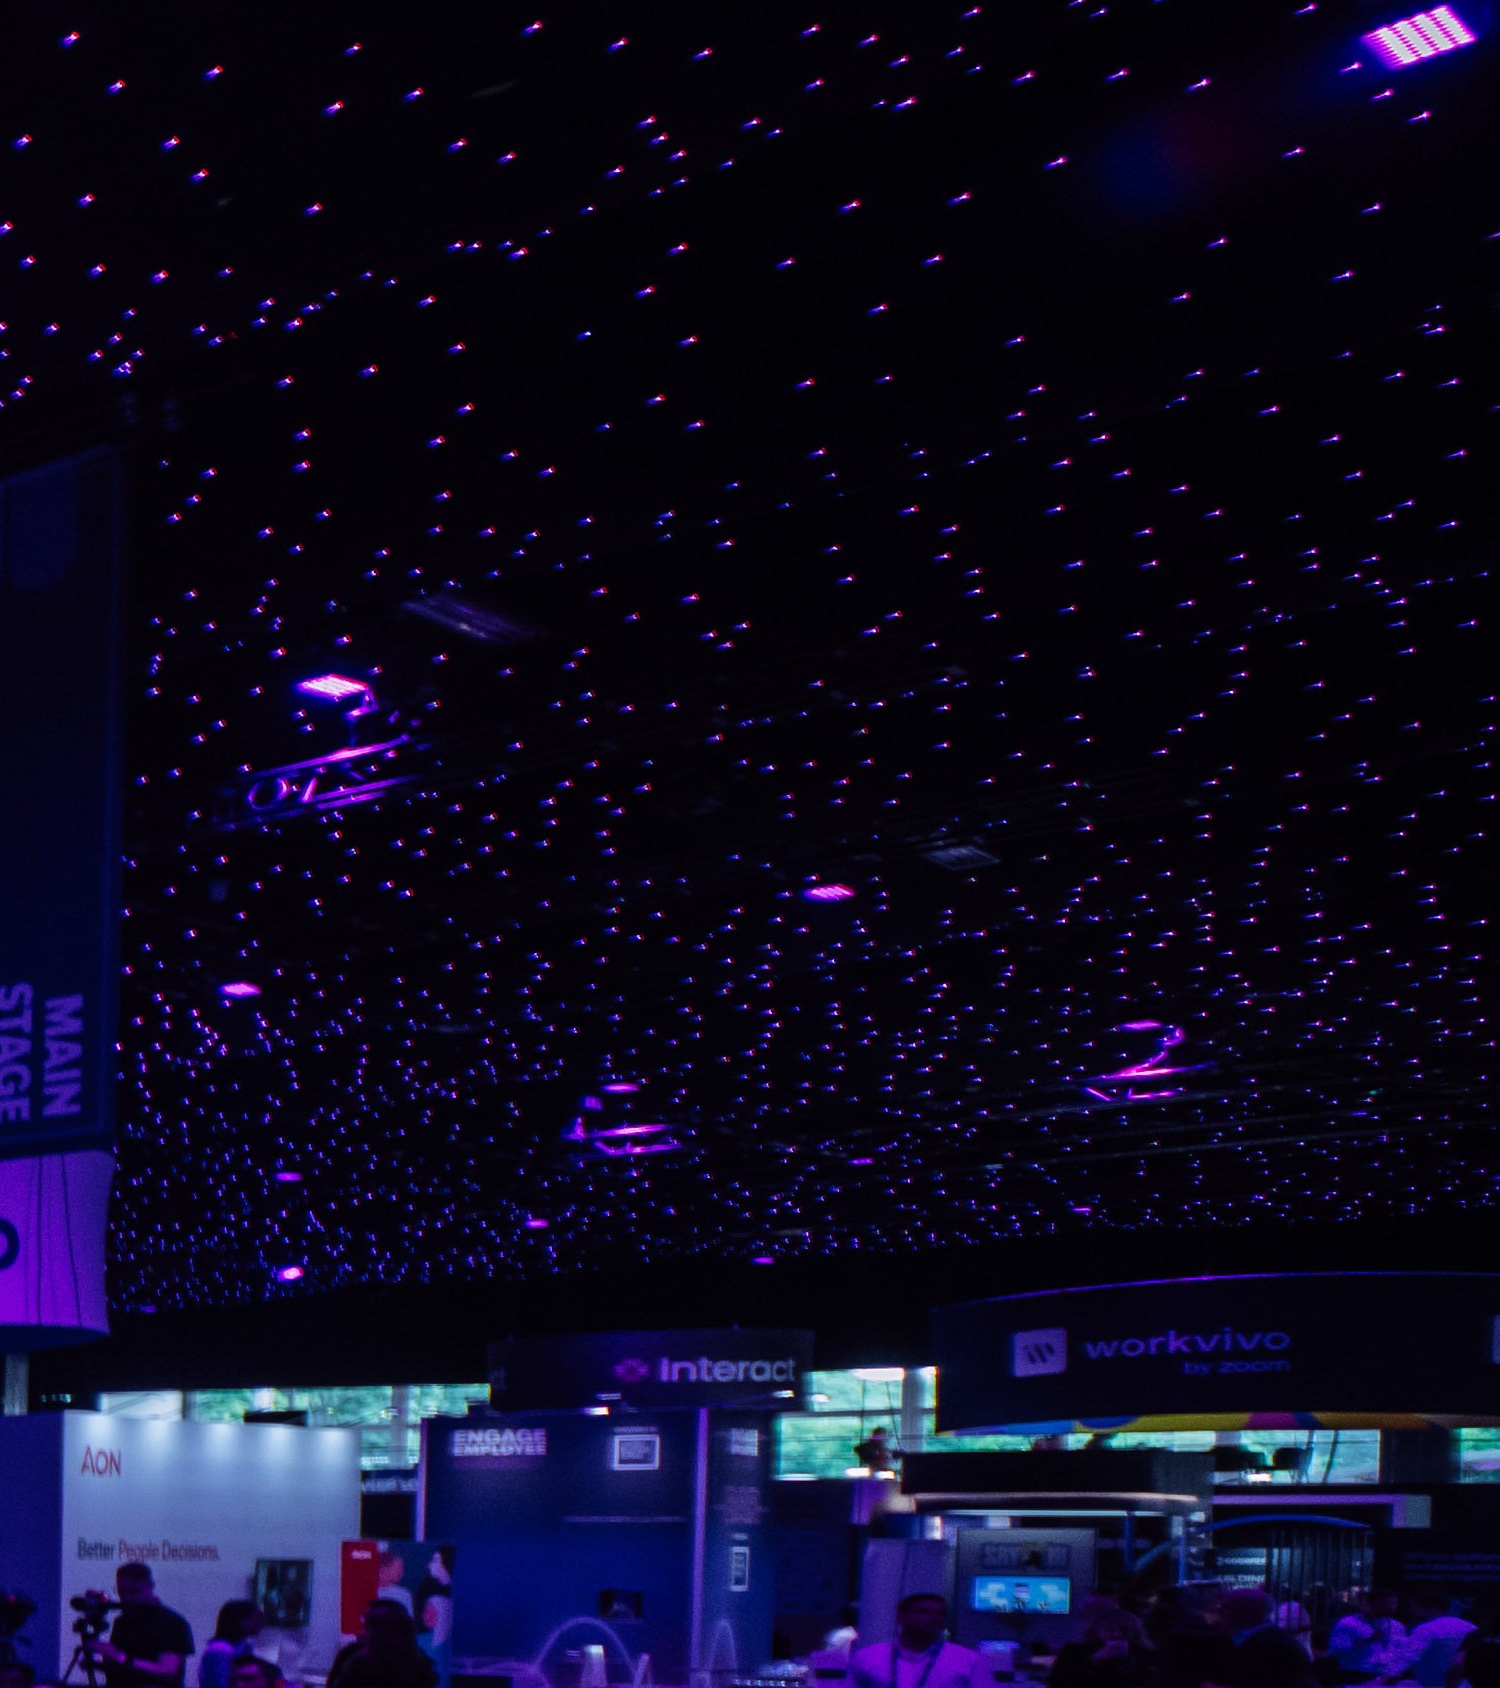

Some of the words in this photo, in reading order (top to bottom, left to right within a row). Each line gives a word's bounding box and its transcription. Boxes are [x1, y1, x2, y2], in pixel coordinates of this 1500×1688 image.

[43, 994, 84, 1117] MAIN
[1083, 1326, 1292, 1360] workvivo
[658, 1355, 797, 1384] Interact
[1182, 1361, 1213, 1377] by
[1218, 1359, 1291, 1375] zoom
[453, 1427, 548, 1444] ENGAGE
[81, 1445, 122, 1476] AON
[453, 1443, 547, 1457] EMPLOYEE
[78, 1537, 115, 1560] Better
[118, 1538, 159, 1562] People
